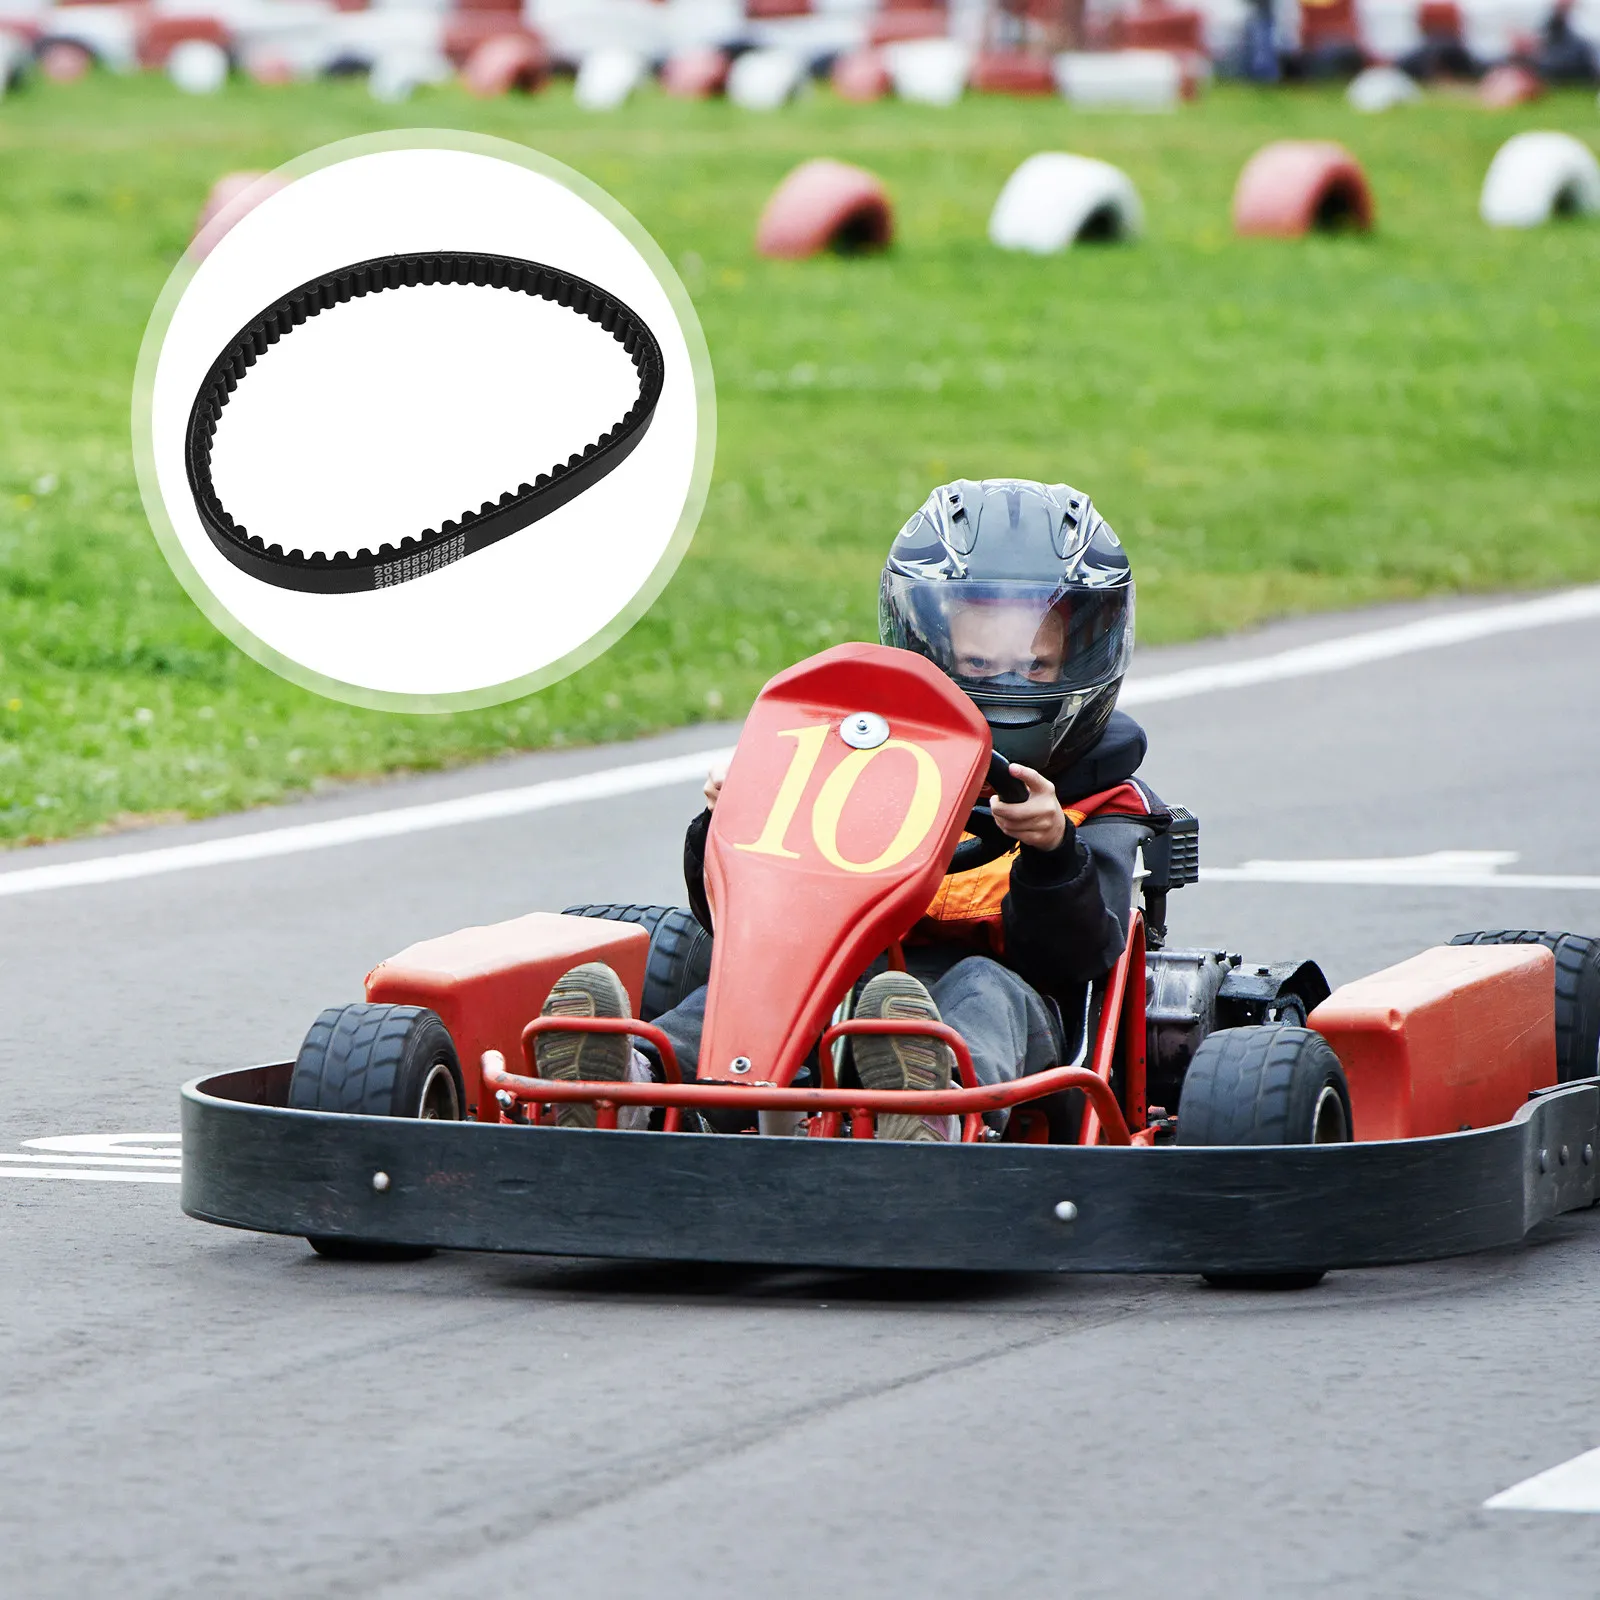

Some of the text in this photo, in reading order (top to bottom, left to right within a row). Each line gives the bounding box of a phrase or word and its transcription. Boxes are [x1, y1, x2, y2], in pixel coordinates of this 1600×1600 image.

[374, 536, 465, 577] 203589/5959
[374, 545, 465, 585] 203589/5959
[734, 724, 942, 873] 10
